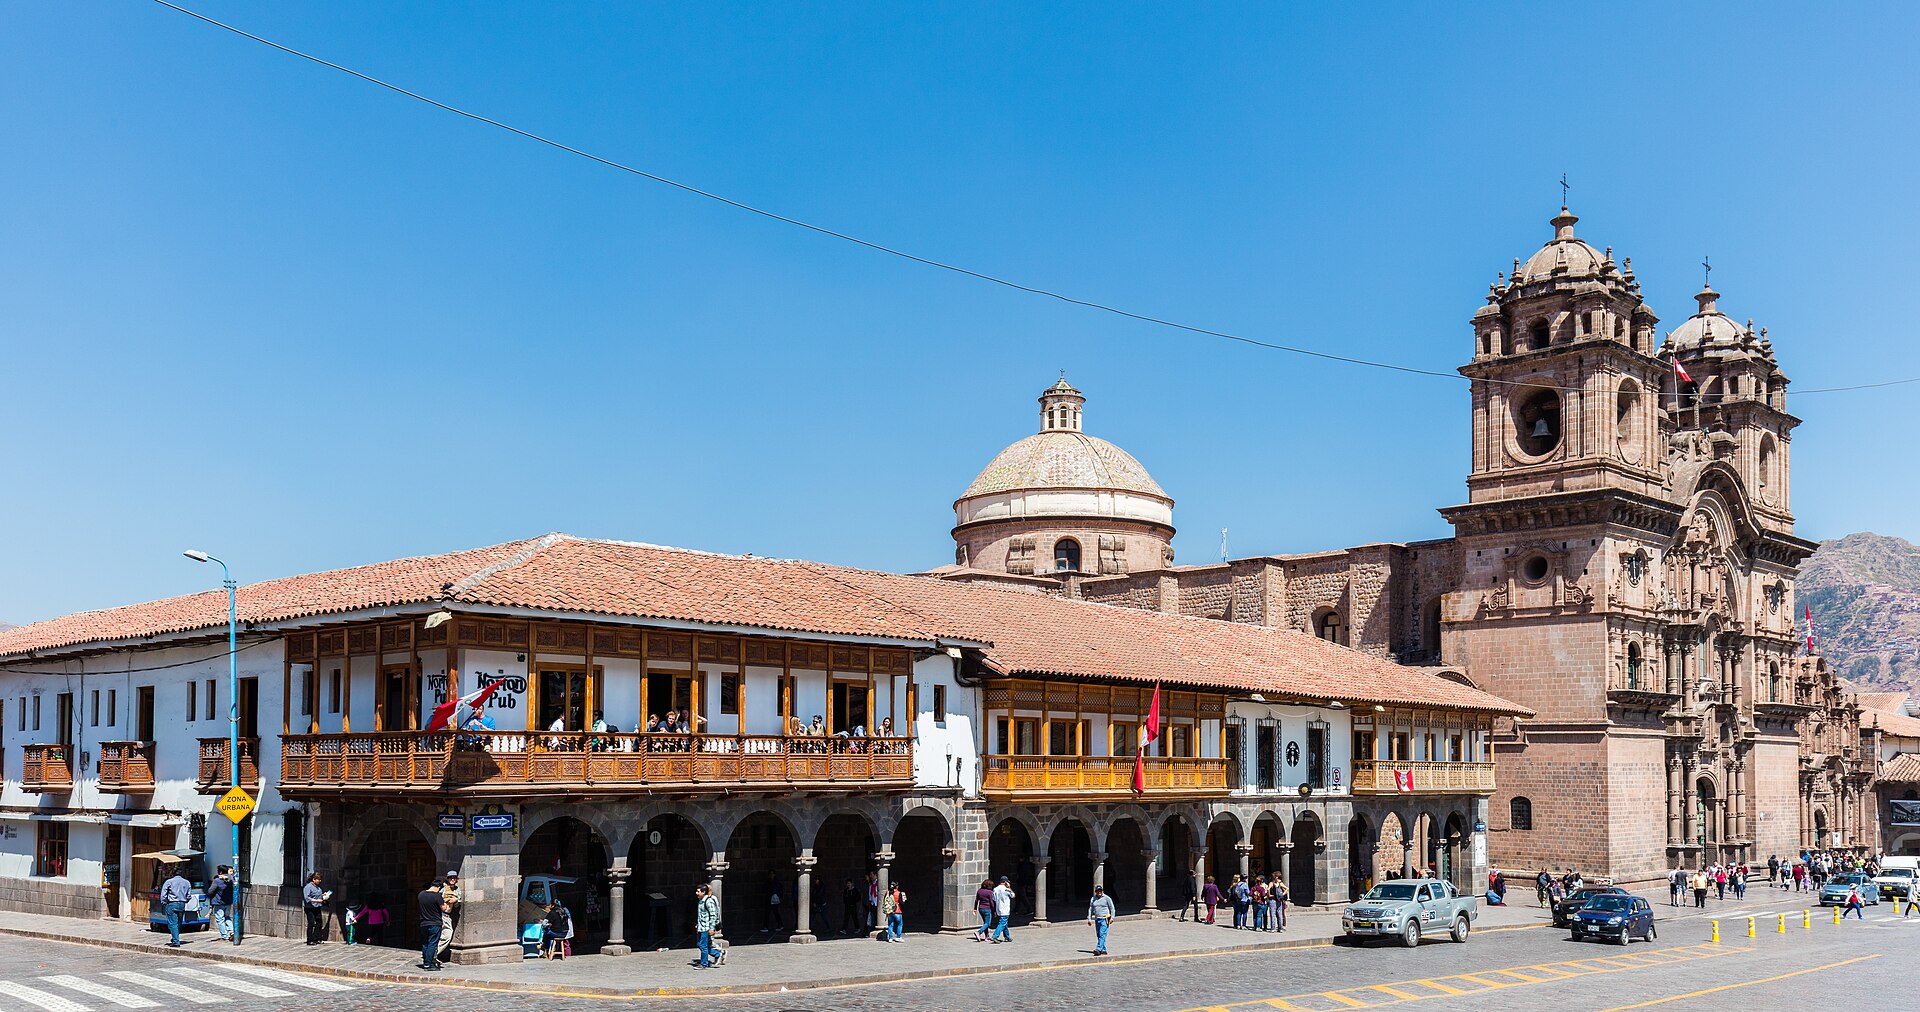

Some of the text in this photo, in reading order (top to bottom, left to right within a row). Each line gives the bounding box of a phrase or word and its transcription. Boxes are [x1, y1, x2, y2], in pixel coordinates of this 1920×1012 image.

[427, 674, 448, 690] Nort
[435, 688, 447, 704] Pu
[488, 691, 516, 709] Pub
